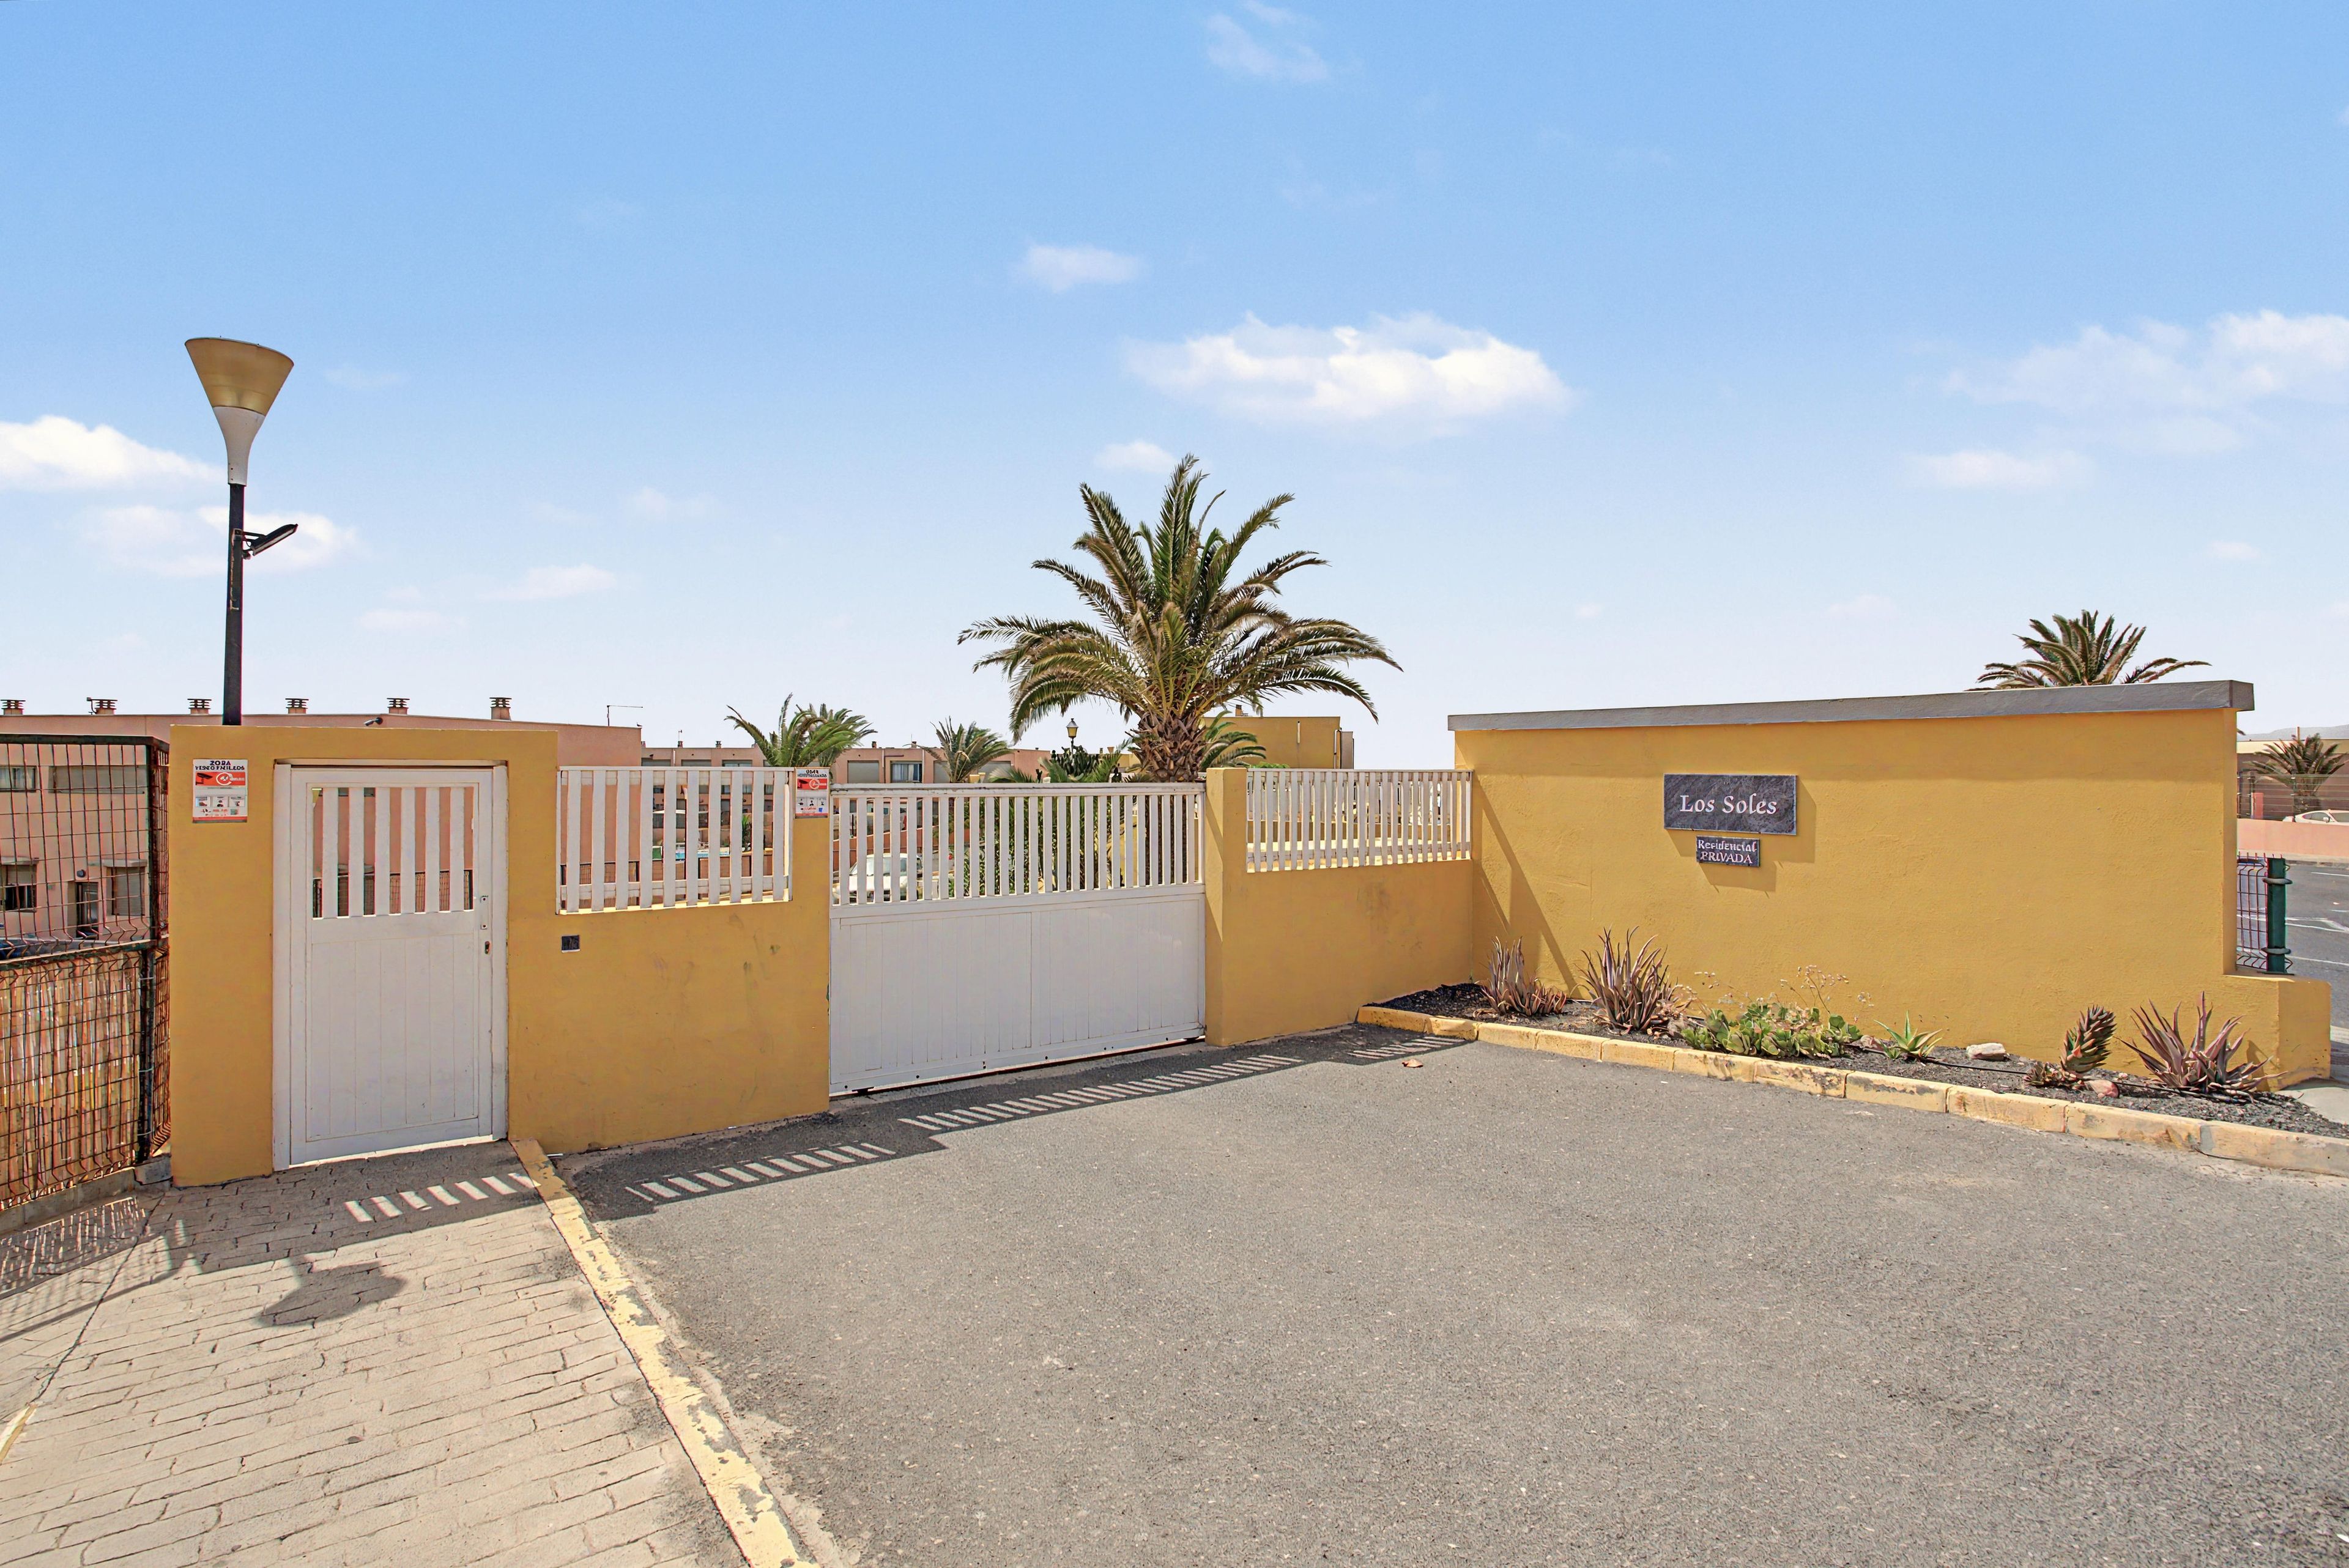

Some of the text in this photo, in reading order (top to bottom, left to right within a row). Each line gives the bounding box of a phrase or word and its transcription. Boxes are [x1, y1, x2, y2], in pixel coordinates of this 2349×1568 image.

[1680, 793, 1777, 815] Los Soles
[1698, 839, 1757, 852] Residencial
[1700, 851, 1753, 864] PRIVADA
